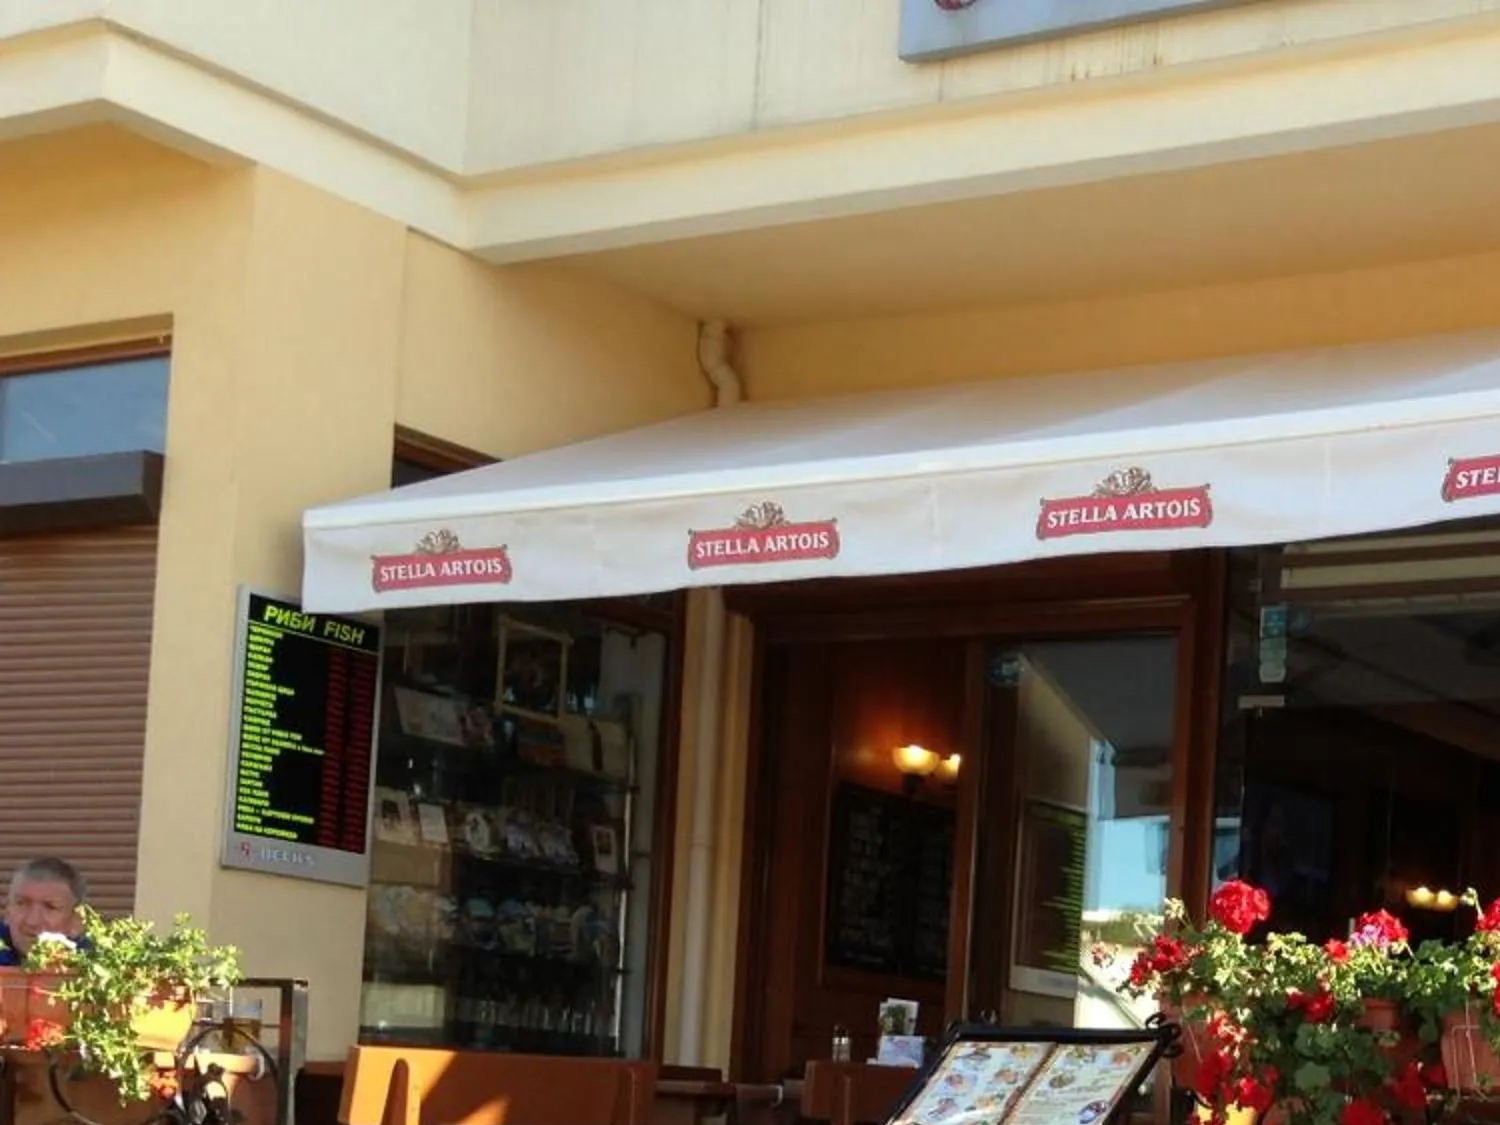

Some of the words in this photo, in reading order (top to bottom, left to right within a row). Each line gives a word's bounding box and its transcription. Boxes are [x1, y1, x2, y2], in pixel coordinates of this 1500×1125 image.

[1047, 504, 1118, 528] STELLA
[1122, 498, 1201, 520] ARTOIS
[695, 537, 760, 558] STELLA
[763, 531, 829, 553] ARTOIS
[380, 562, 436, 582] STELLA
[439, 557, 503, 577] ARTOIS
[264, 604, 316, 632] РИБИ
[323, 621, 365, 645] FISH
